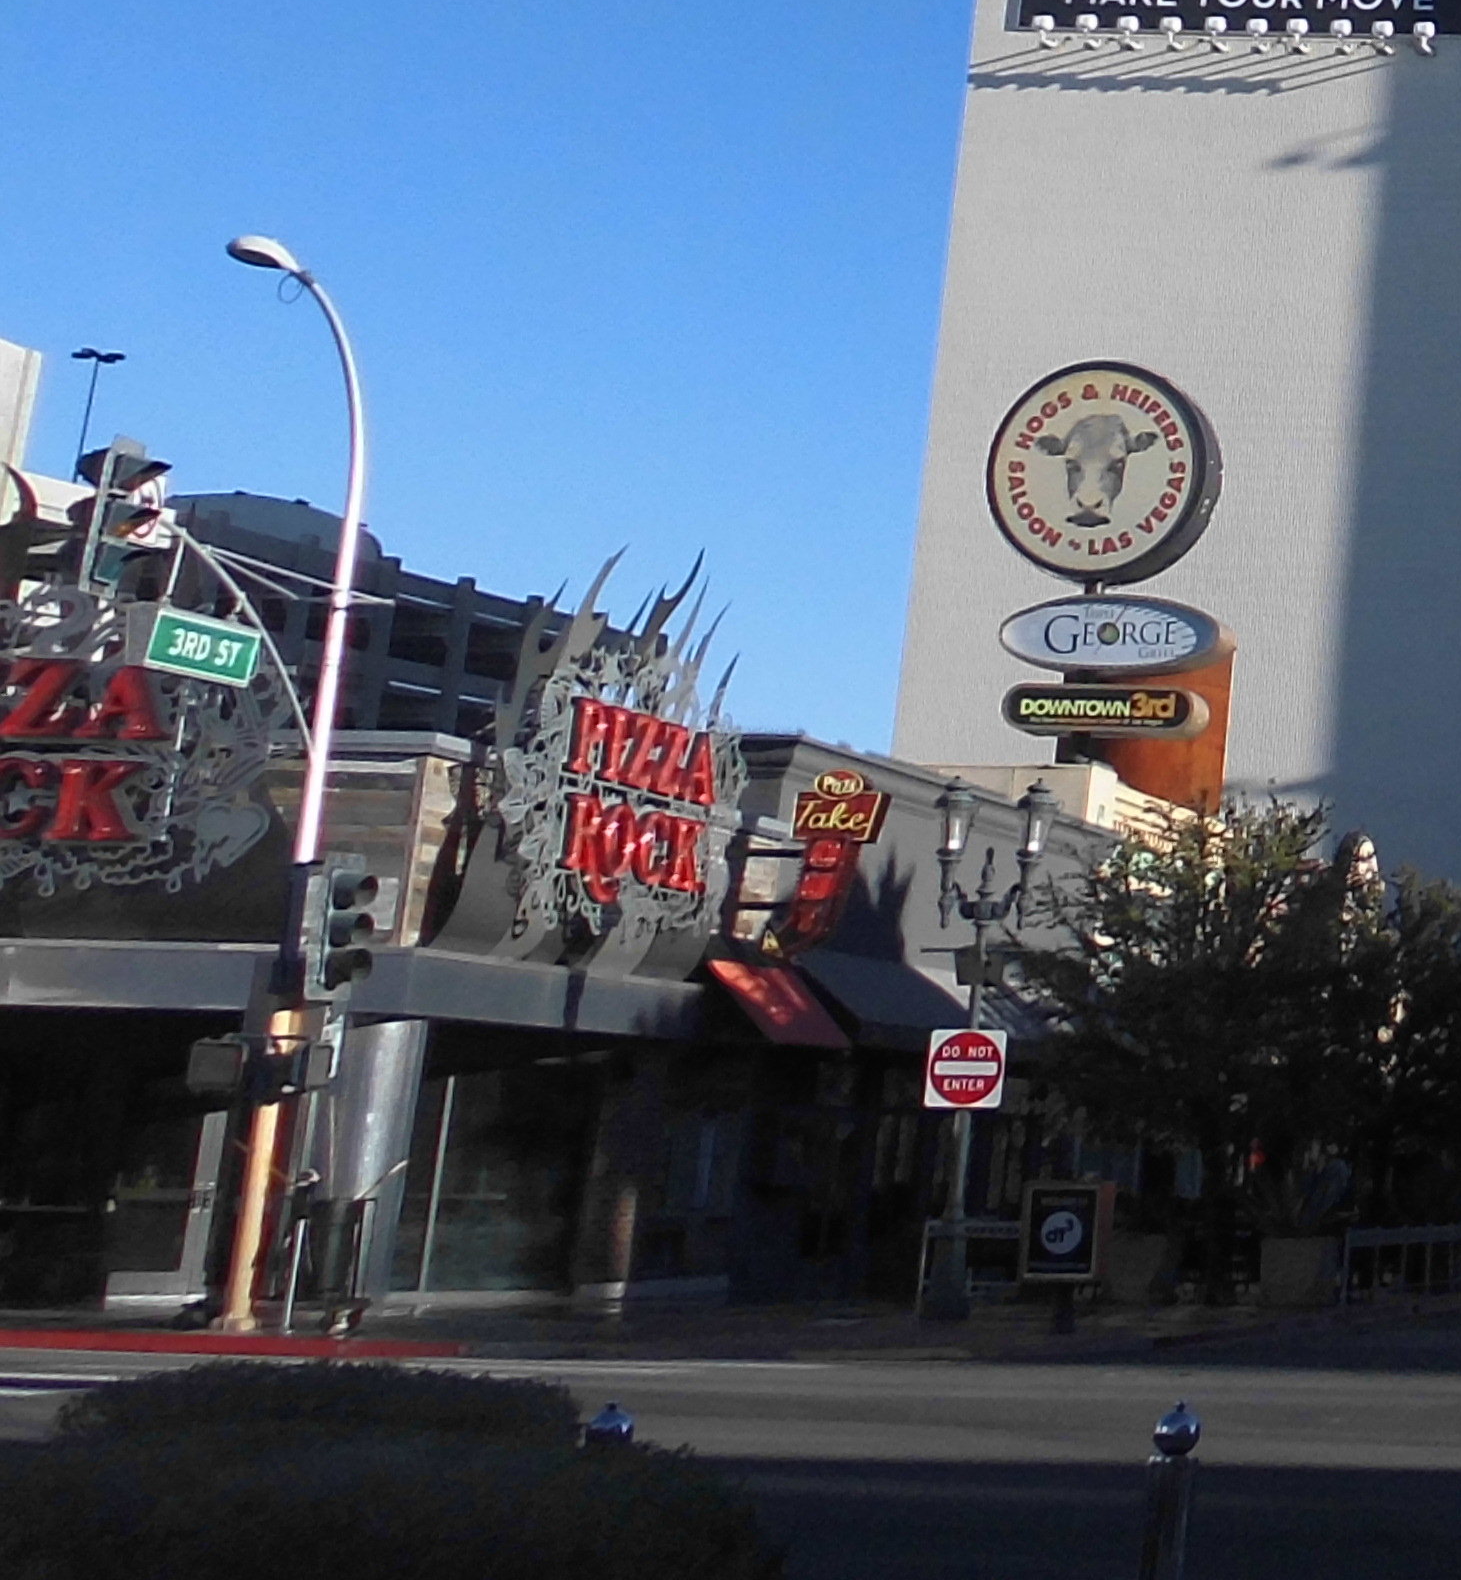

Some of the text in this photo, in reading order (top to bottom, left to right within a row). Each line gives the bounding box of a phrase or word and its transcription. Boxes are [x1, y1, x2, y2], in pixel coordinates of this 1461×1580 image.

[1015, 383, 1184, 452] HOGS & HEIFERS
[1008, 460, 1187, 556] SALOON LAS VEGAS
[168, 628, 243, 667] 3RD ST
[1044, 614, 1178, 654] GEORGE
[561, 697, 715, 806] PIZZA
[797, 799, 869, 830] Take
[557, 790, 706, 904] ROCK
[942, 1045, 994, 1059] DO NOT
[943, 1078, 985, 1092] ENTER
